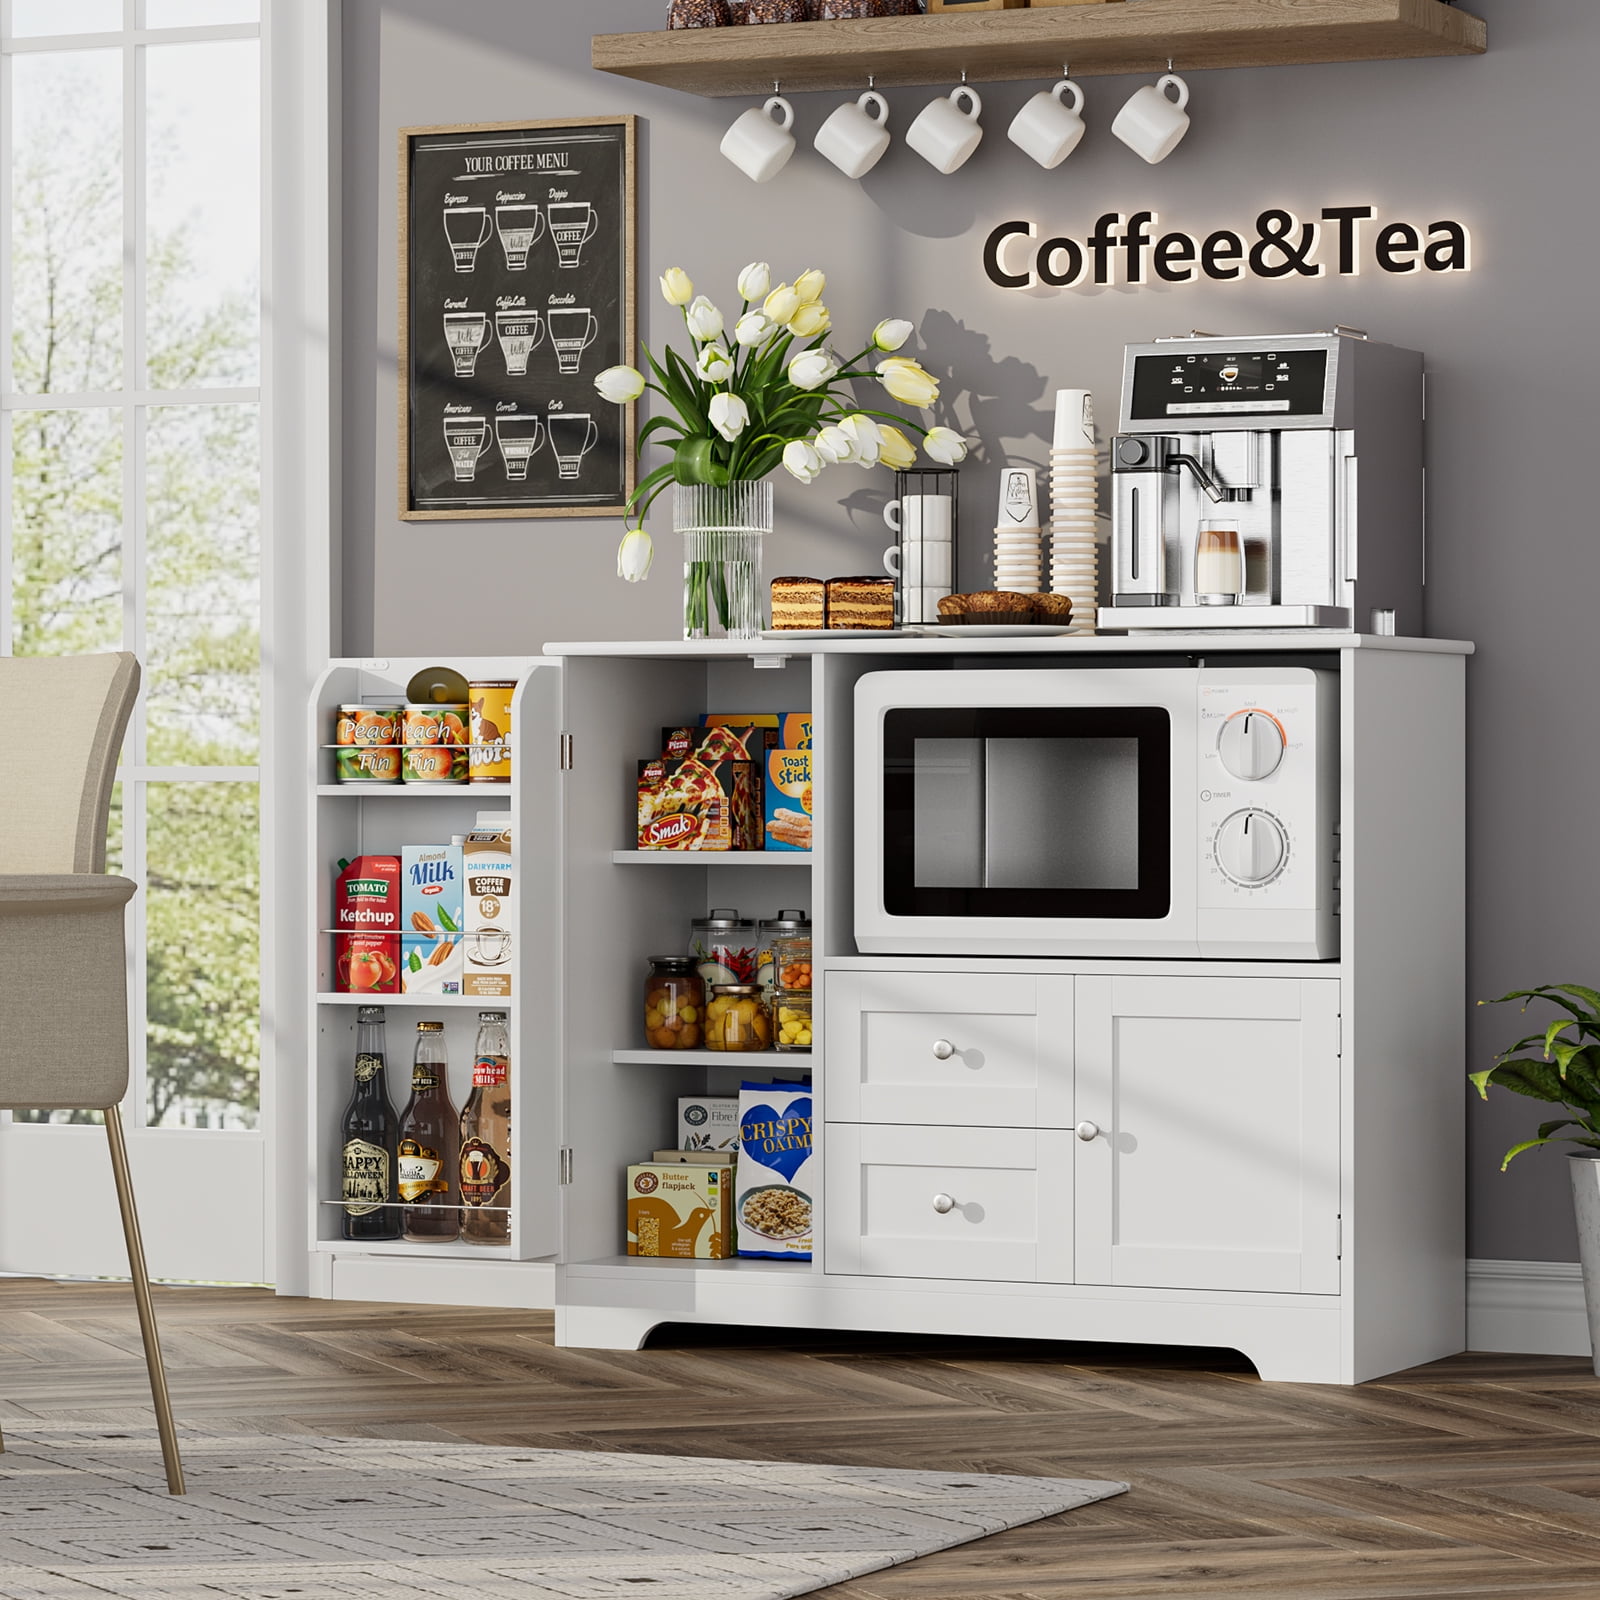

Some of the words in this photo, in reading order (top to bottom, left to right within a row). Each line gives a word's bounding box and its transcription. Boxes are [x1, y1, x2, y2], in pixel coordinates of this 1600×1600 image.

[465, 156, 493, 173] YOUR
[495, 154, 534, 171] COFFEE
[536, 152, 569, 169] MENU
[444, 193, 469, 206] Espresso
[496, 191, 526, 205] Cappuccino
[549, 188, 569, 202] Doppio
[556, 230, 582, 241] COFFEE
[456, 252, 474, 260] COFFEE
[508, 253, 525, 261] COFFEE
[561, 248, 577, 256] COFFEE
[457, 328, 474, 343] Milk
[505, 325, 529, 335] COFFEE
[455, 347, 474, 355] COFFEE
[560, 354, 577, 362] COFFEE
[444, 402, 472, 414] Americano
[453, 436, 477, 446] COFFEE
[508, 461, 525, 469] COFFEE
[561, 463, 577, 471] COFFEE
[344, 722, 400, 738] Peach
[358, 753, 390, 770] Tin
[408, 754, 436, 770] Tin
[781, 756, 809, 767] Toast
[650, 815, 690, 844] Smak
[419, 851, 446, 862] Almond
[467, 863, 512, 871] DAIRYFARM
[409, 861, 455, 886] Milk
[475, 877, 504, 886] COFFEE
[347, 883, 388, 893] TOMATO
[475, 886, 504, 894] CREAM
[340, 909, 395, 926] Ketchup
[712, 1112, 733, 1121] Fibre
[740, 1116, 812, 1141] CRISPY
[763, 1134, 812, 1154] OATM
[662, 1173, 689, 1181] Butter
[662, 1182, 696, 1191] flapjack
